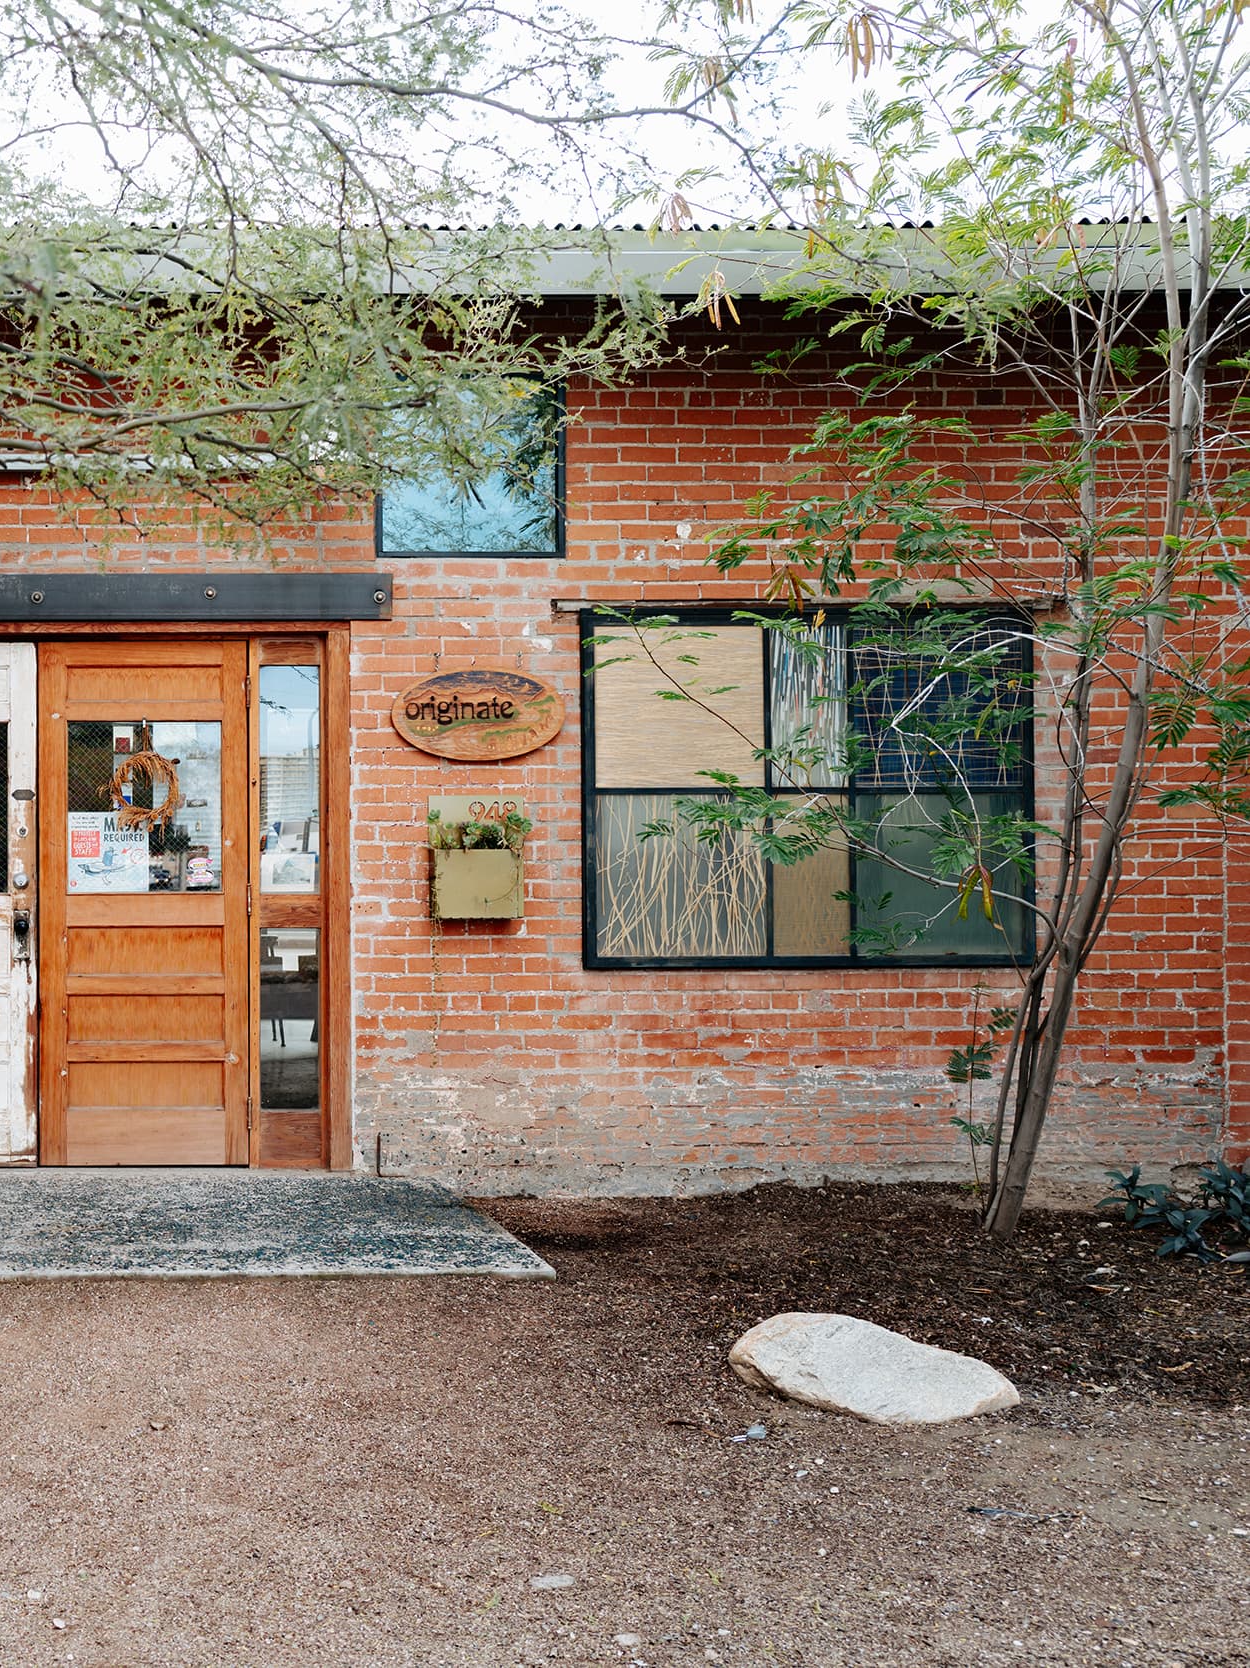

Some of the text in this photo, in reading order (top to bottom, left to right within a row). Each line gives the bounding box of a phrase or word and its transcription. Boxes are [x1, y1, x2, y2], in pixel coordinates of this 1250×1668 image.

[405, 695, 514, 726] originate
[468, 801, 517, 822] 948
[103, 833, 145, 842] REQUIRED
